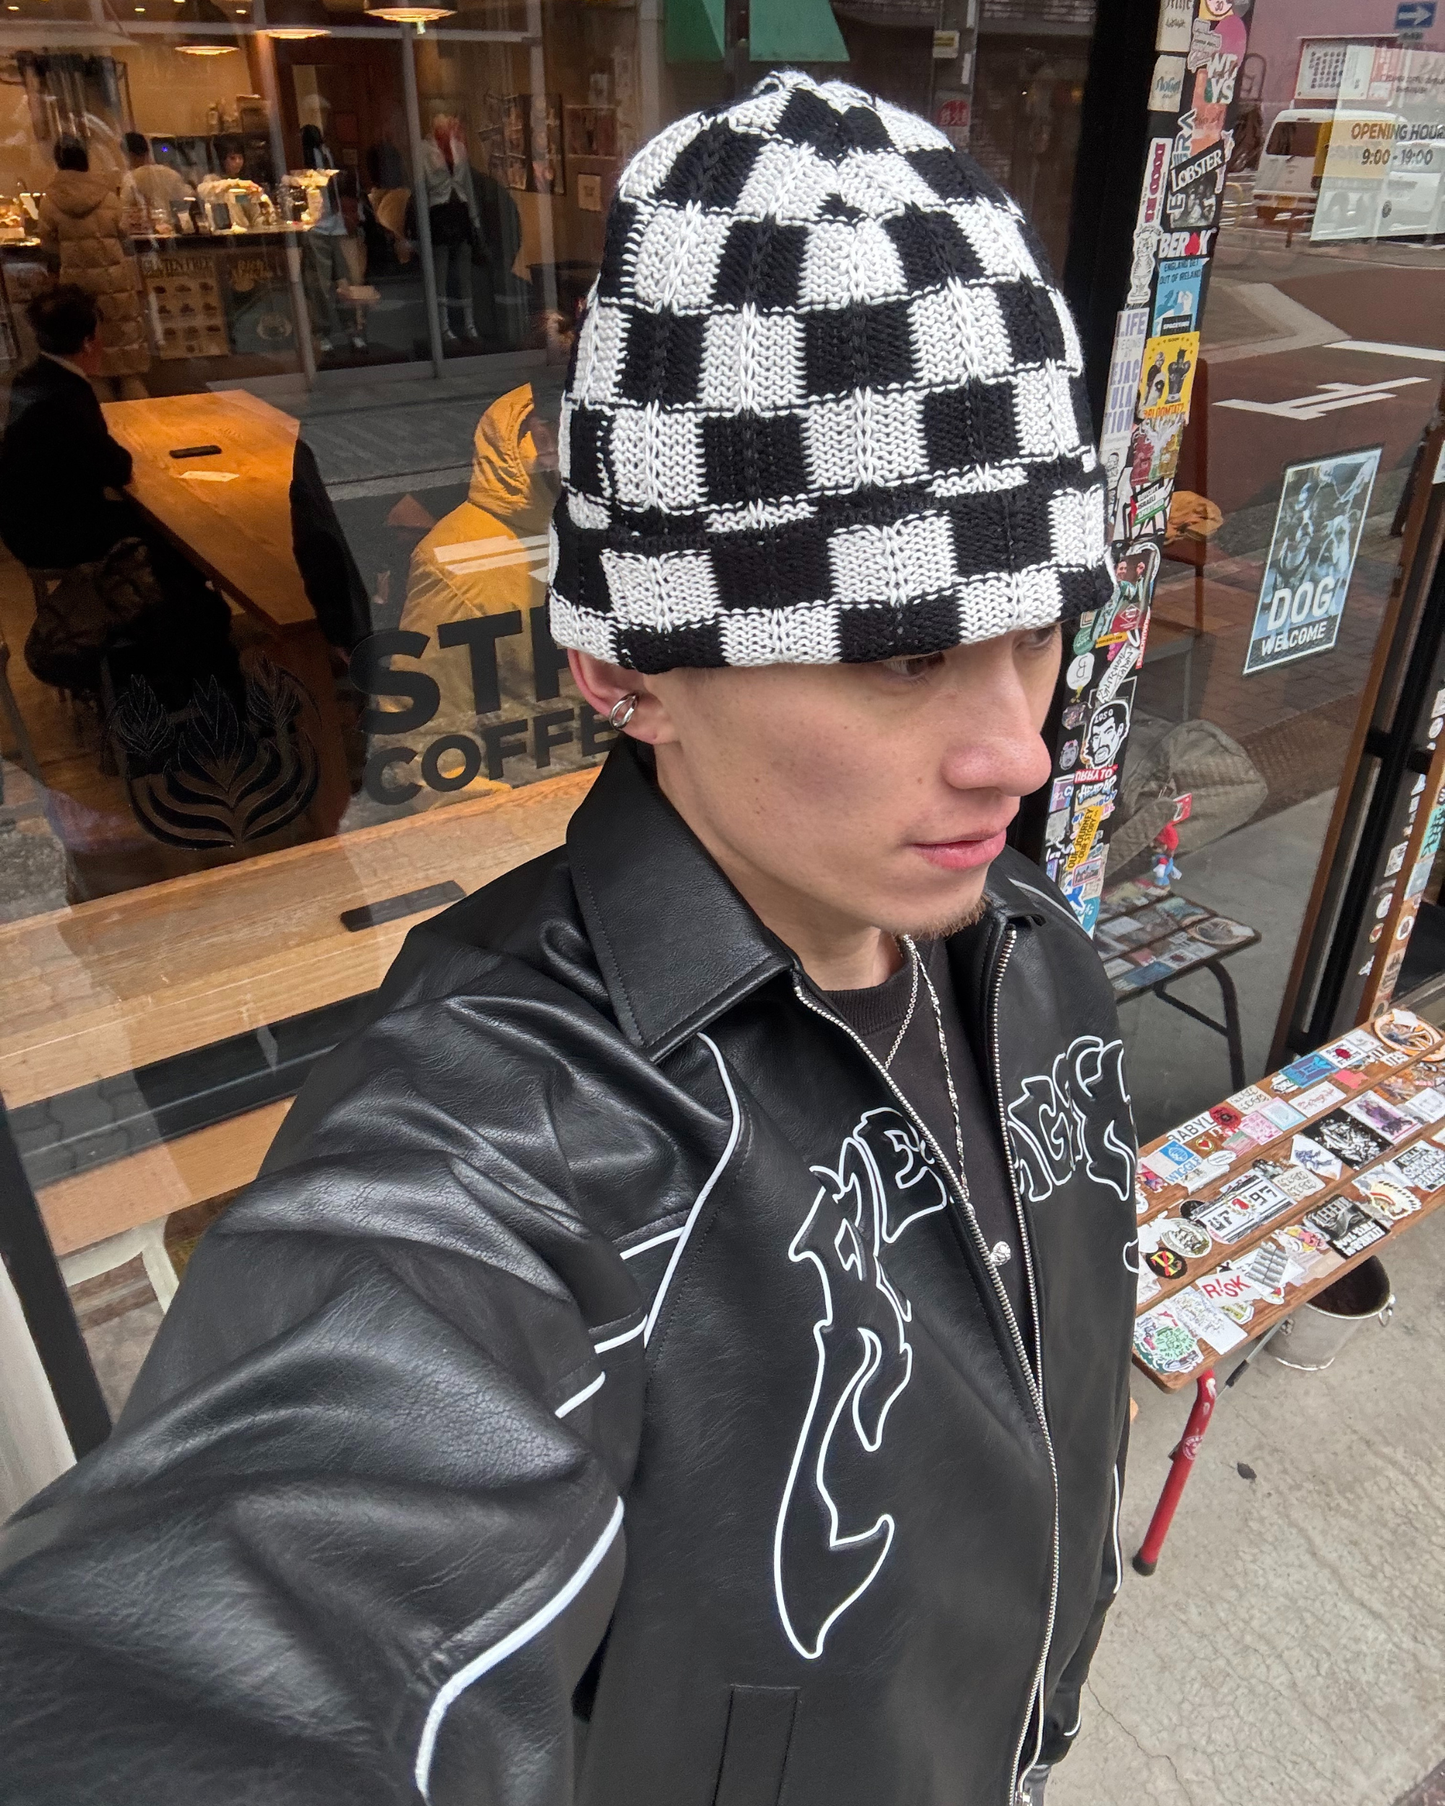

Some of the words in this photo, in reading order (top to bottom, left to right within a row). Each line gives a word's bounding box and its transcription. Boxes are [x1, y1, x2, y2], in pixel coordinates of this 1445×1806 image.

[1350, 122, 1408, 140] OPENING
[1361, 148, 1391, 166] 9:00
[1401, 148, 1434, 166] 19:00
[1171, 149, 1223, 193] LOBSTER
[1159, 276, 1171, 285] OUT
[1172, 274, 1179, 283] OF
[1179, 270, 1201, 281] IRELAND
[1267, 575, 1335, 631] DOG
[1261, 621, 1328, 657] WELCOME
[1067, 850, 1079, 869] OUR
[1075, 808, 1094, 847] JOURNEY
[1084, 818, 1097, 841] STORY
[1165, 1155, 1203, 1183] WIGGLE
[1201, 1274, 1252, 1299] R!SK
